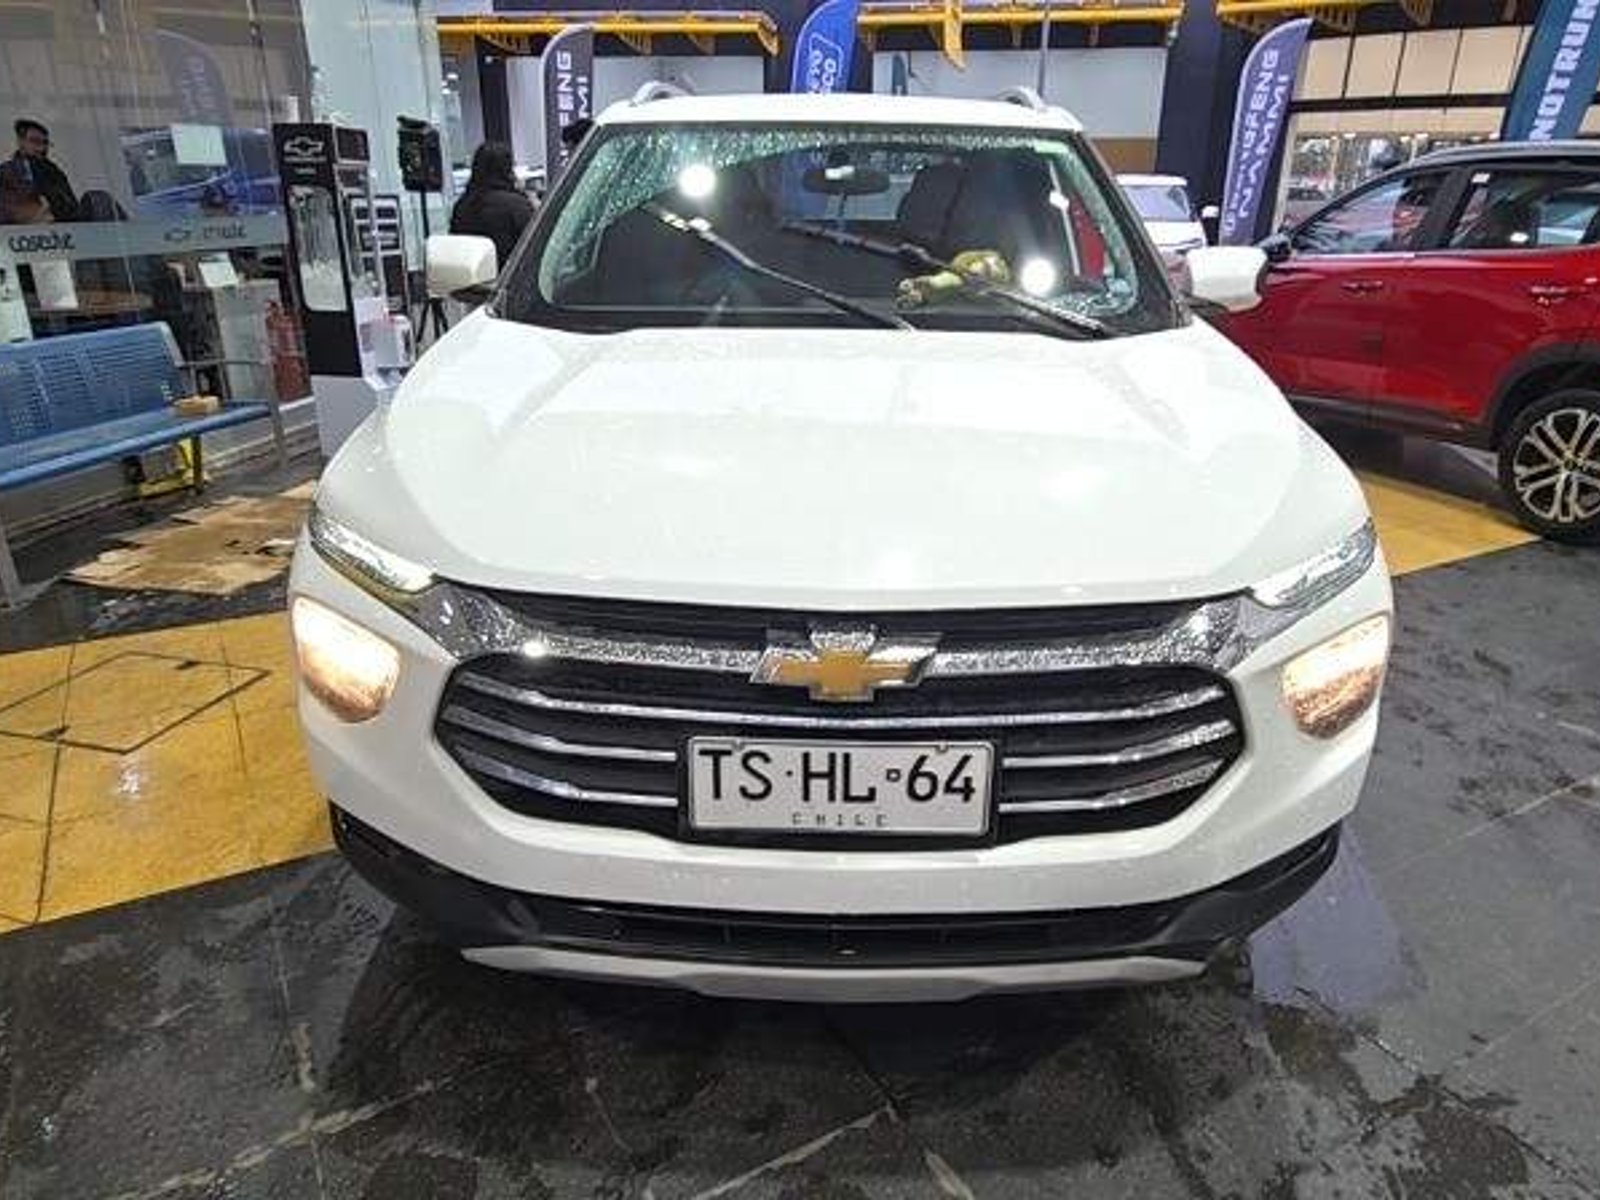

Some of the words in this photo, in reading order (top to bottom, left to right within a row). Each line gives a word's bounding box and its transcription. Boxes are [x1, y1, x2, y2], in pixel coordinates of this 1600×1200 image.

[576, 75, 591, 119] MI
[1528, 0, 1598, 144] NOTRUK
[1239, 73, 1290, 218] NAMMI
[792, 813, 889, 827] CHILE
